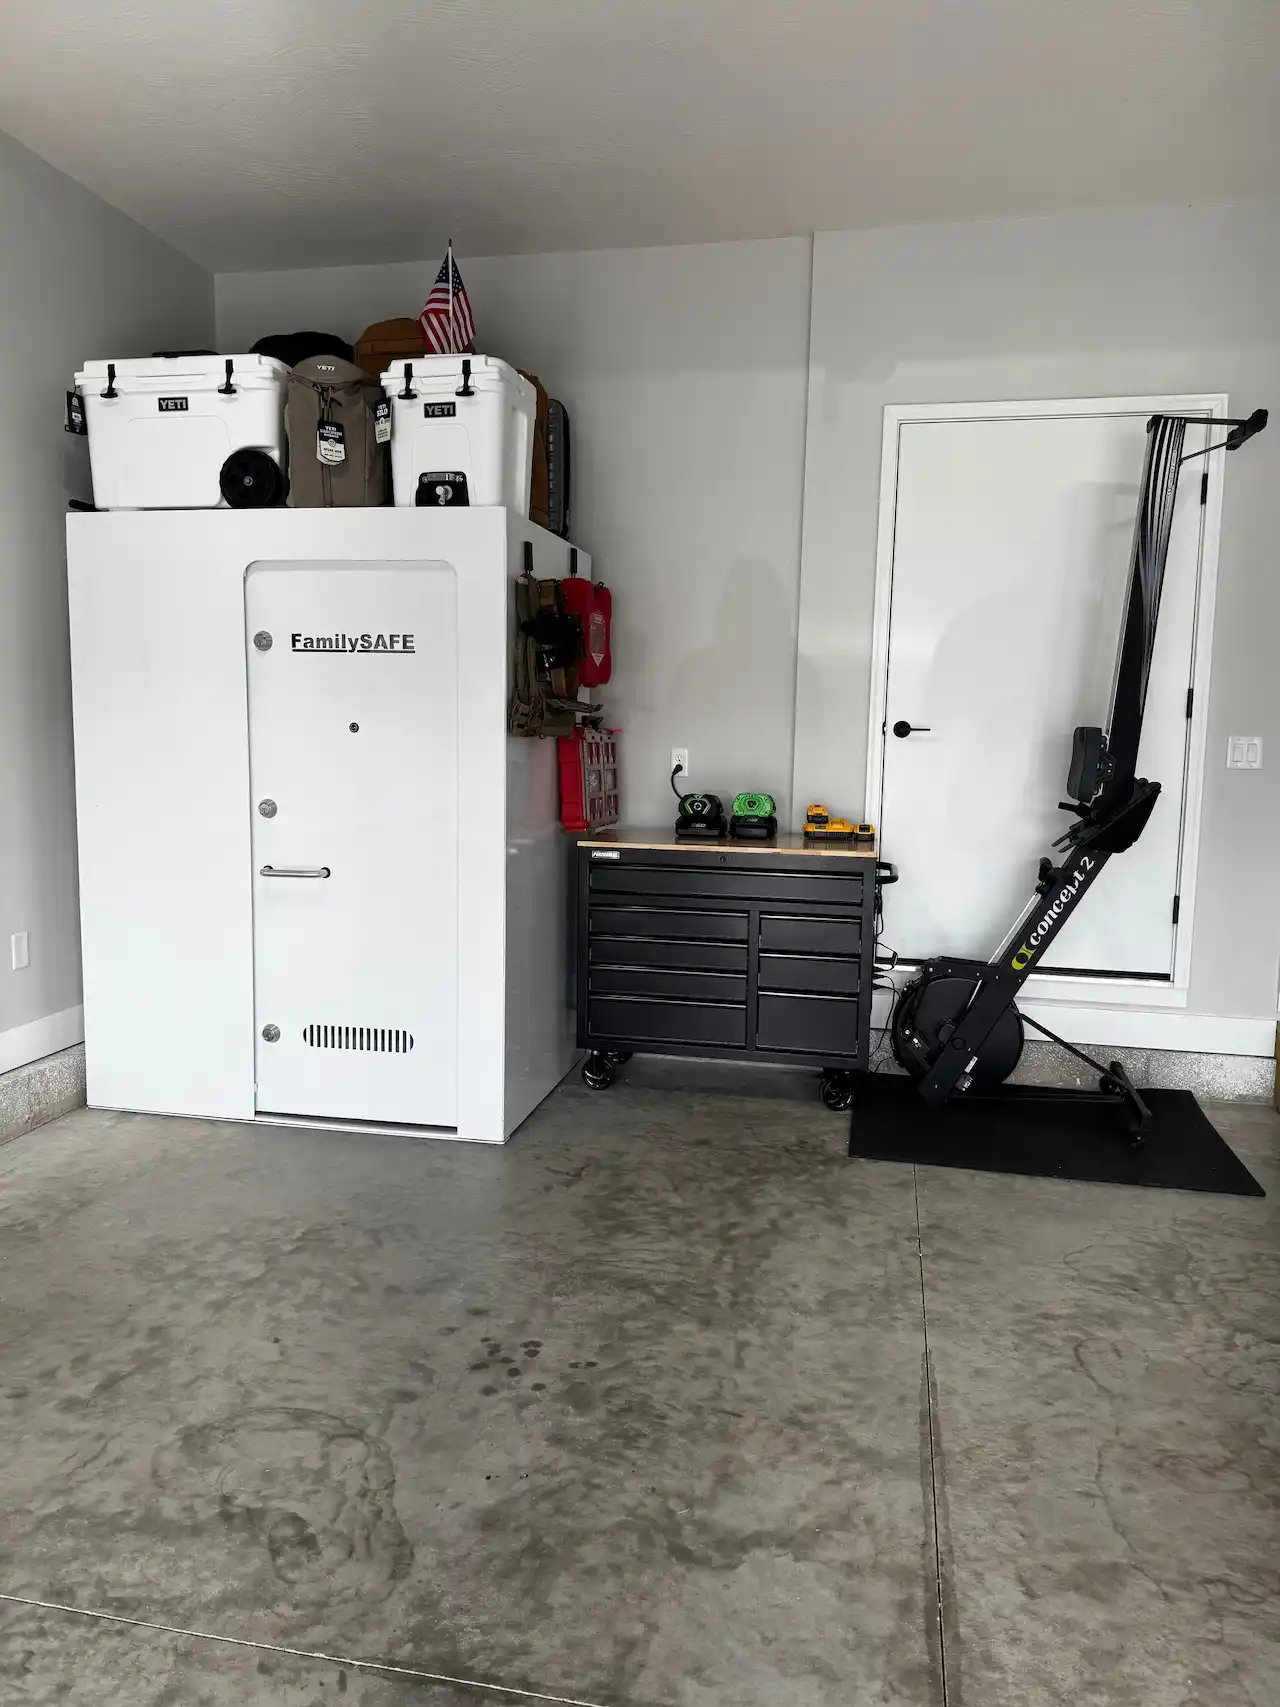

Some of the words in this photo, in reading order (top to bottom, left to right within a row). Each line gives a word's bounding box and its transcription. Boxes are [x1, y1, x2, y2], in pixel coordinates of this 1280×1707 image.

[316, 364, 335, 372] YETI
[160, 399, 187, 409] YETI
[426, 404, 454, 416] YETI
[291, 633, 416, 653] FamilySAFE
[1030, 869, 1085, 946] concept
[1080, 856, 1095, 871] 2
